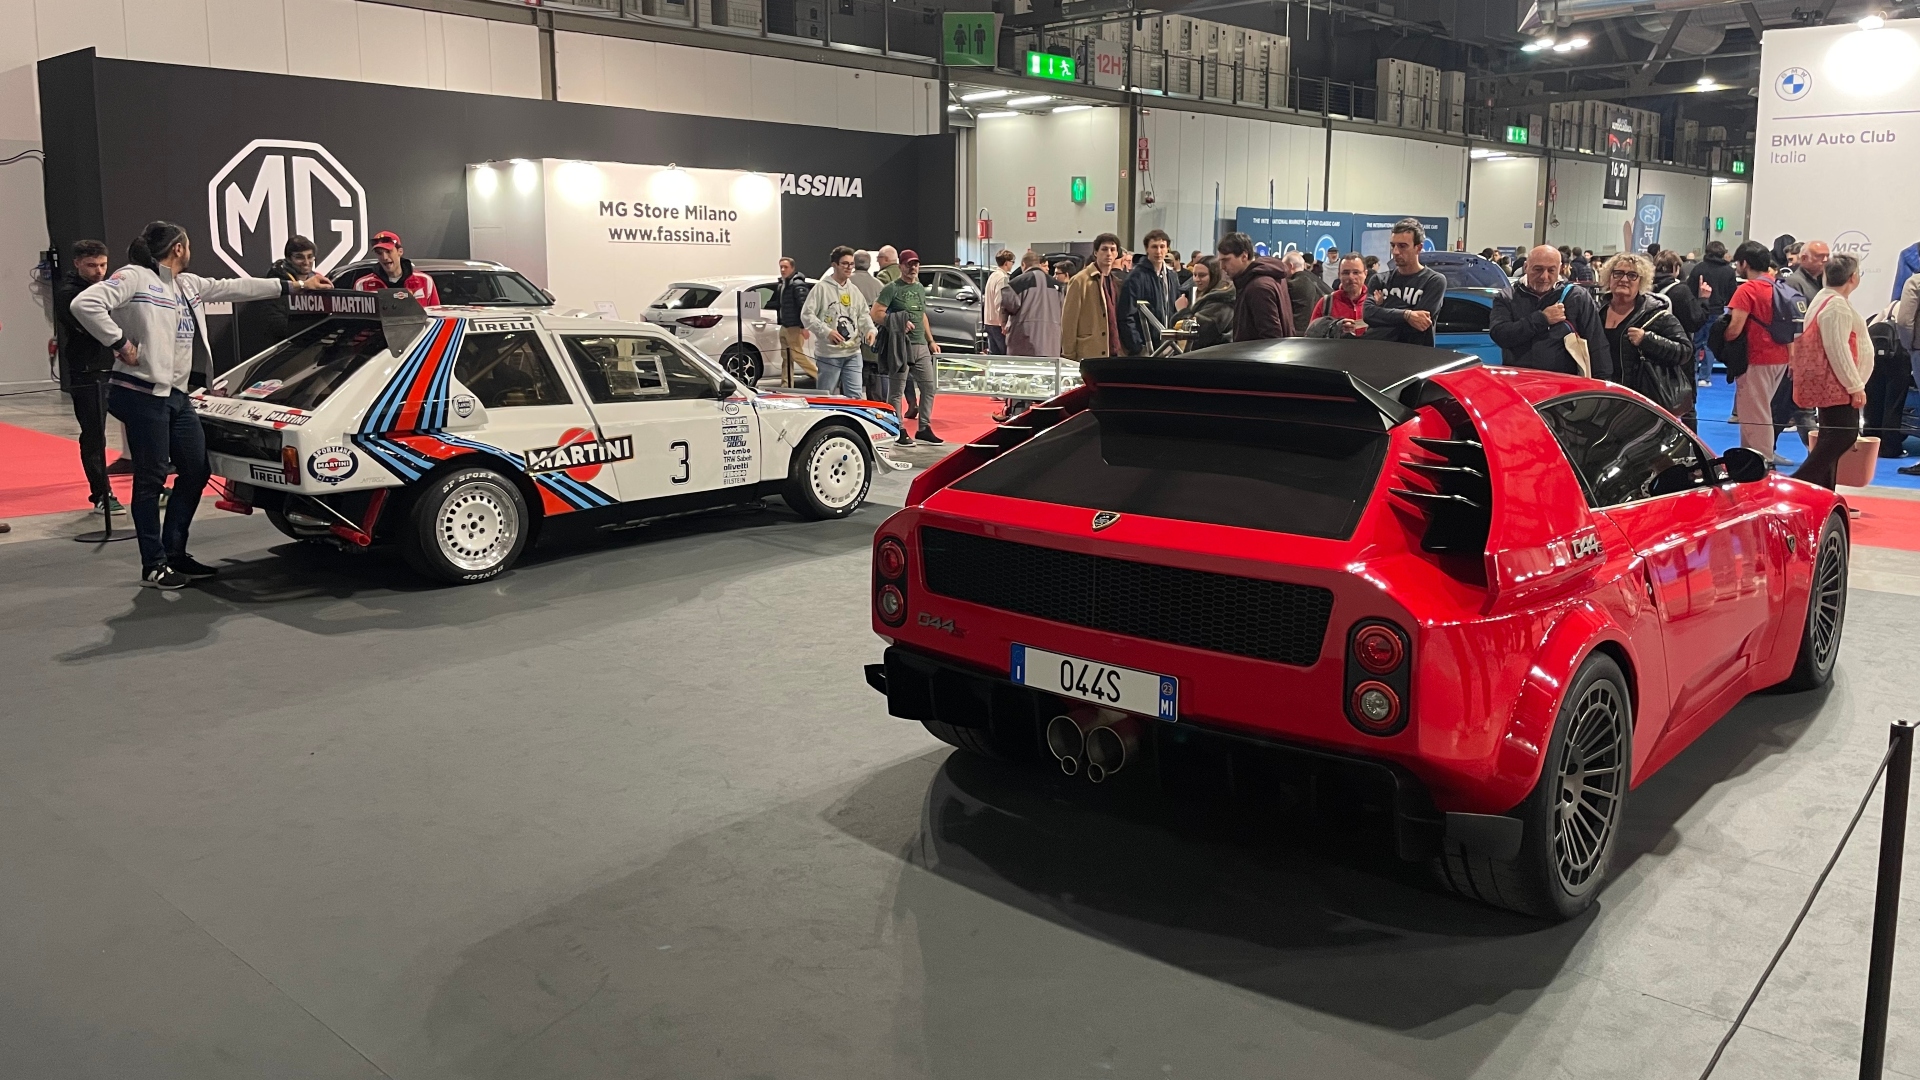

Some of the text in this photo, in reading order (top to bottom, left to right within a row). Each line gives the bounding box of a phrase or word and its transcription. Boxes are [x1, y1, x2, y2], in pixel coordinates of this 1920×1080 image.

[1096, 54, 1121, 76] 12H
[1771, 130, 1896, 147] BMW Auto Club
[1770, 151, 1806, 164] Italia
[780, 173, 863, 198] ASSINA
[224, 154, 354, 279] MG
[599, 201, 738, 222] MG Store Milano
[608, 225, 731, 244] www.fassina.it
[1831, 243, 1872, 252] MRC
[288, 294, 325, 312] LANCIA
[331, 295, 376, 314] MARTINI
[744, 300, 757, 309] A07
[468, 316, 535, 331] PIRELLI
[267, 411, 309, 425] MARTINI
[871, 432, 887, 441] WEBER
[313, 445, 353, 459] SPORTLINE
[723, 448, 751, 456] brembo
[317, 459, 350, 470] MARTINI
[528, 438, 692, 486] MARTINI 3
[723, 462, 749, 471] olivetti
[442, 472, 496, 493] SP SPORT
[723, 477, 746, 485] BILSTEIN
[850, 480, 869, 510] DUNLOP
[462, 564, 504, 580] DUNLOP
[1016, 665, 1021, 680] I
[1060, 660, 1122, 703] 044S
[1162, 684, 1172, 694] 23
[1160, 698, 1173, 716] MI
